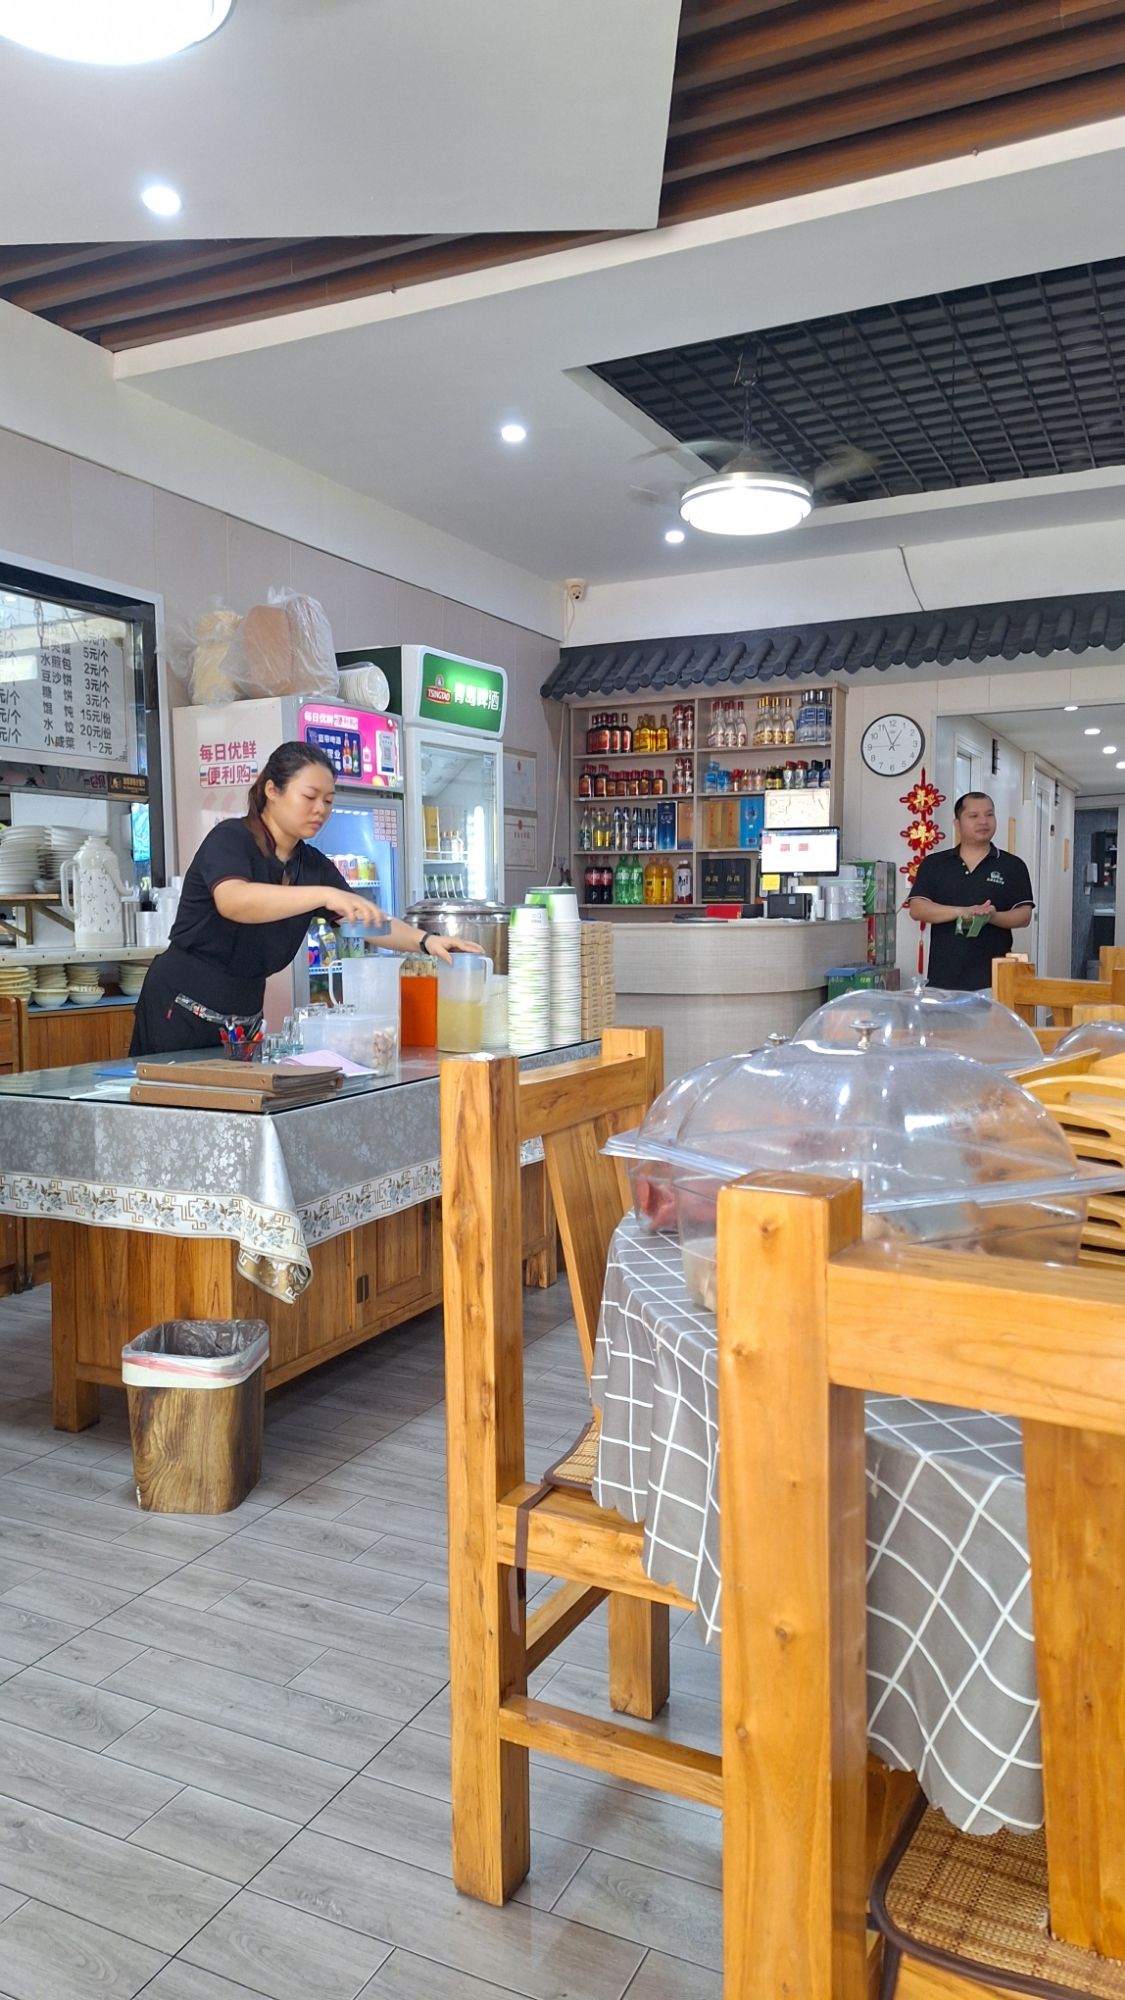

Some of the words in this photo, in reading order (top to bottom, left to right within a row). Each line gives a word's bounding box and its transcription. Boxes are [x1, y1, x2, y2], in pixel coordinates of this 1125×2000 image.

[83, 647, 109, 662] 5元/个
[40, 653, 72, 671] 水煎包
[84, 663, 110, 678] 2元/个
[41, 670, 73, 687] 豆沙饼
[85, 678, 110, 694] 3元/个
[86, 694, 111, 709] 3元/个
[80, 709, 111, 725] 15元/份
[80, 724, 112, 740] 20元/份
[87, 740, 112, 756] 1-2元
[199, 740, 257, 762] 每日优鲜
[207, 764, 251, 786] 便利购
